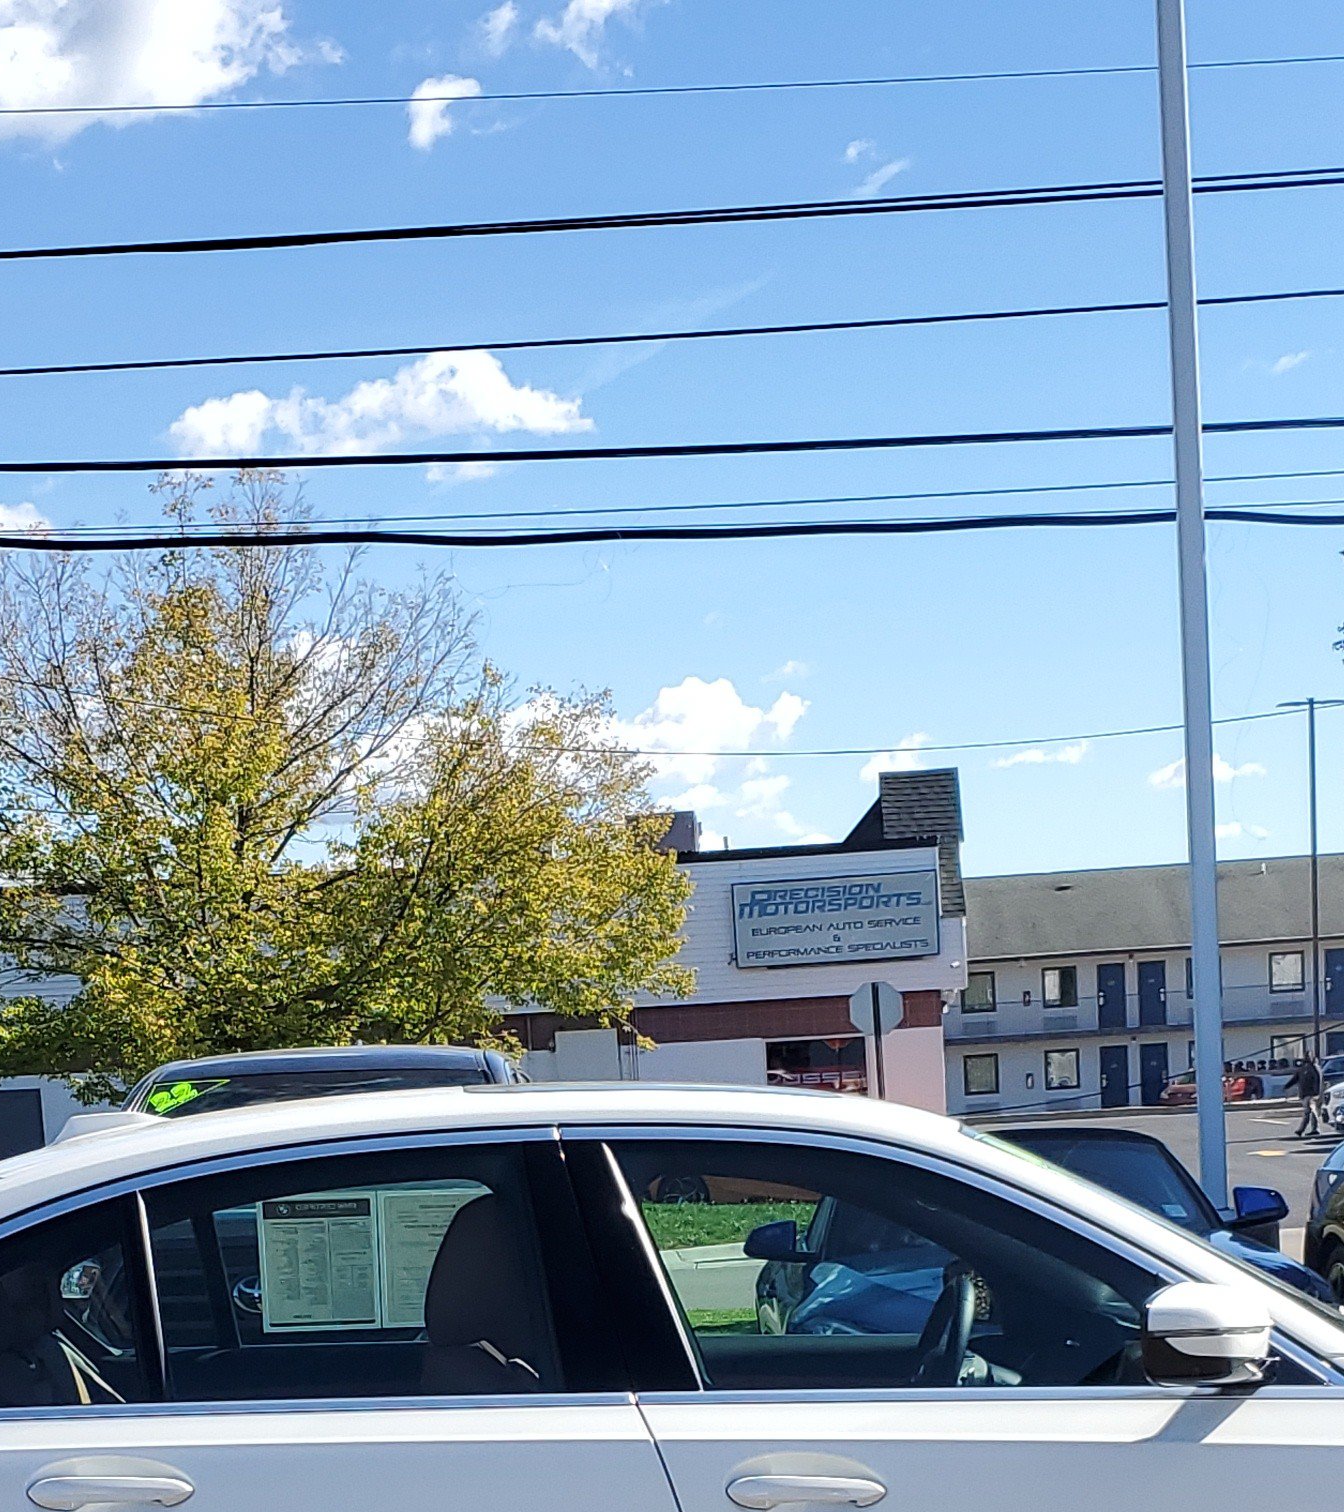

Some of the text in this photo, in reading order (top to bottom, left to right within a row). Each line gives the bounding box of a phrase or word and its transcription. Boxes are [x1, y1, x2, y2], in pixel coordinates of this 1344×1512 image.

[750, 882, 883, 903] PRECISION
[738, 891, 922, 919] MOTORSPORTS
[751, 916, 922, 937] EUROPEAN AUTO SERVICE
[832, 934, 841, 942] &
[746, 938, 930, 960] PERFORMANCE SPECIALISTS
